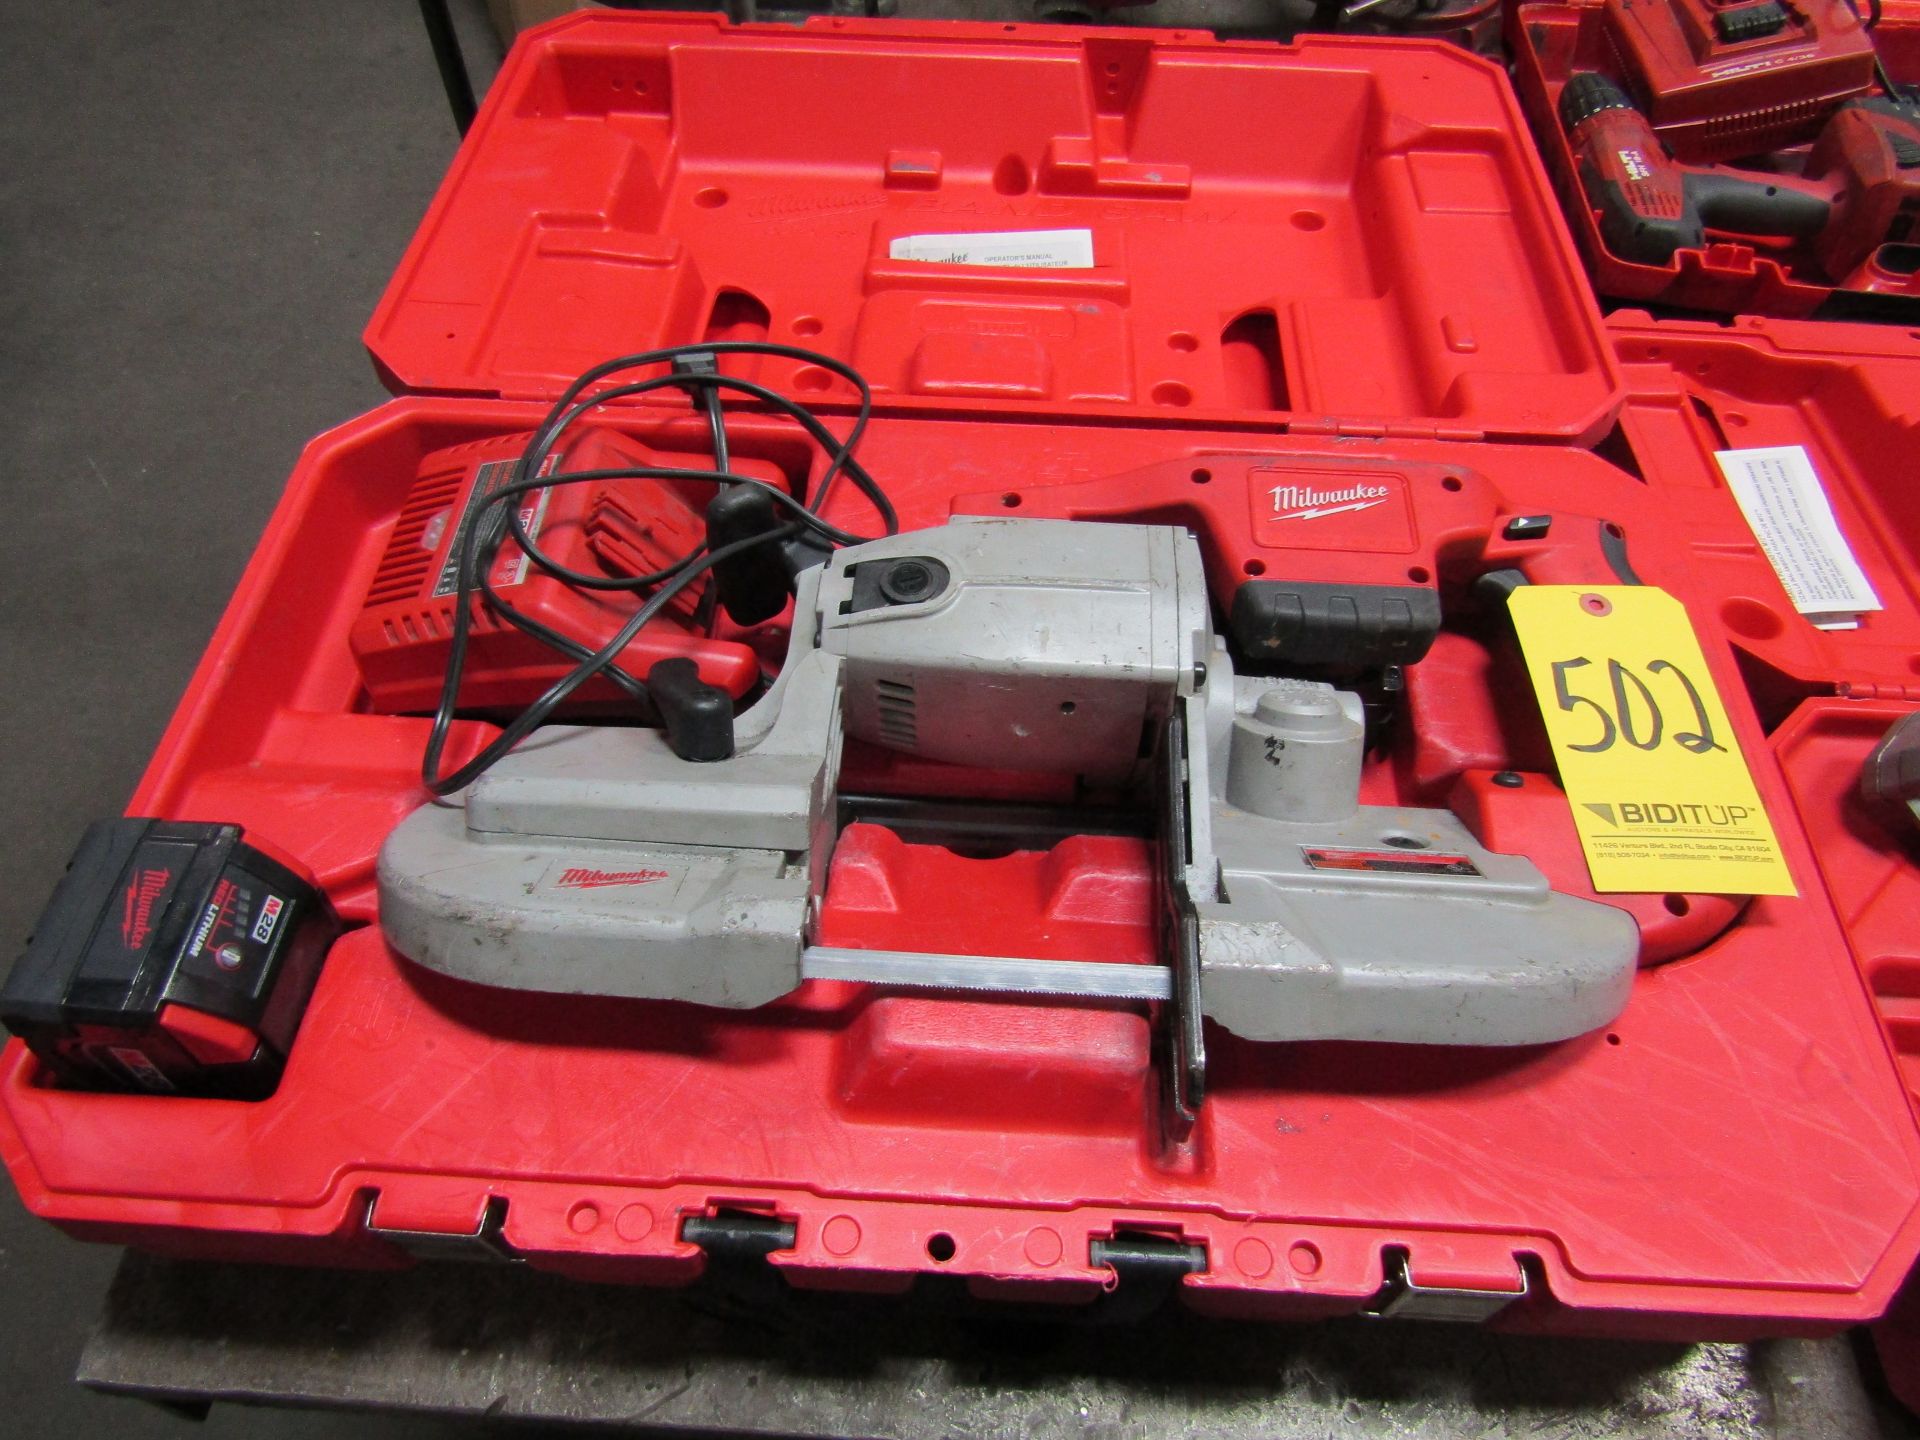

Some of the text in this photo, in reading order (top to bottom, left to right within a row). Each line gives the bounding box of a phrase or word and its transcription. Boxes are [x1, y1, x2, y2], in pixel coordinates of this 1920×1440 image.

[1025, 253, 1053, 261] MANUAL
[1265, 482, 1391, 512] Milwaukee
[1551, 656, 1729, 754] 502
[558, 867, 669, 885] Milwaukee
[131, 867, 171, 950] Milwaukee
[256, 899, 281, 941] M28
